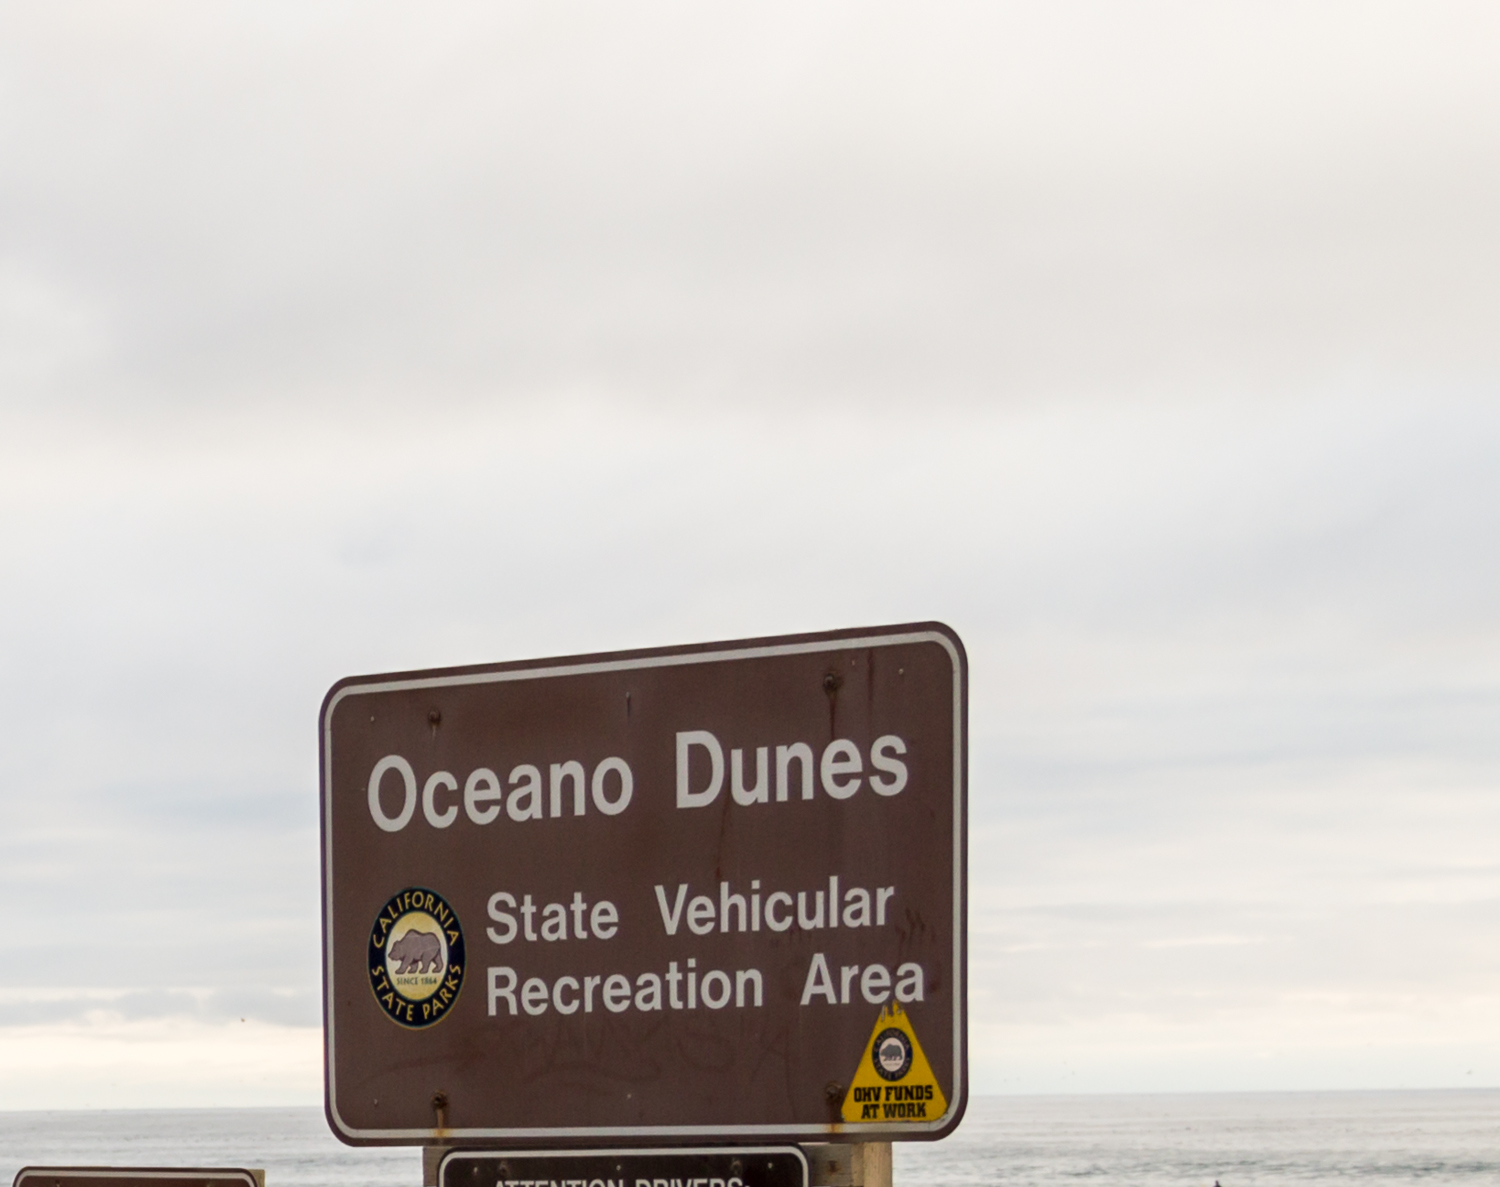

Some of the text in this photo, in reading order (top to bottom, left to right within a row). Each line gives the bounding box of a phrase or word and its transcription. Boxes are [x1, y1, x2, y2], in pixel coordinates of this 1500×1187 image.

[366, 729, 909, 833] Oceano Dunes
[373, 891, 460, 948] CALIFORNIA
[486, 875, 896, 945] State Vehicular
[372, 965, 461, 1021] STATE PARKS
[397, 977, 437, 985] SINCE 1864
[486, 953, 925, 1017] Recreation Area
[854, 1085, 933, 1102] OHV FUNDS
[862, 1103, 926, 1119] AT WORK
